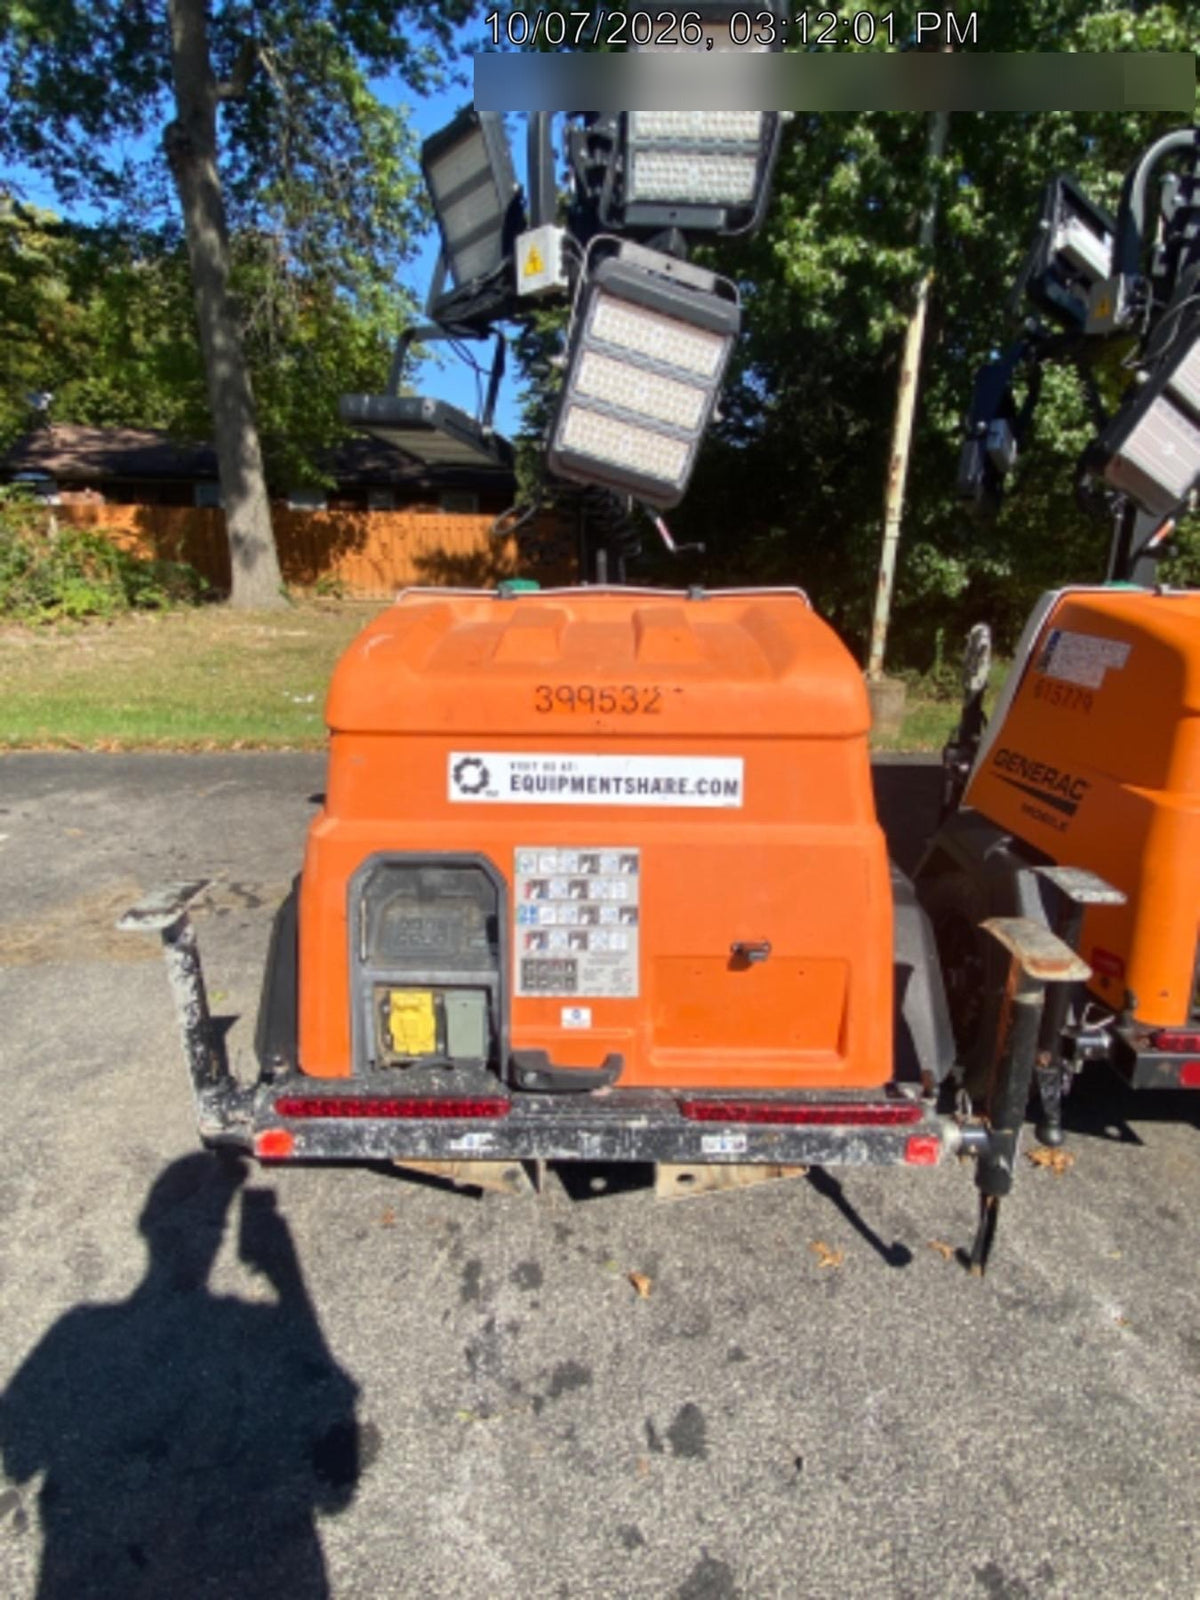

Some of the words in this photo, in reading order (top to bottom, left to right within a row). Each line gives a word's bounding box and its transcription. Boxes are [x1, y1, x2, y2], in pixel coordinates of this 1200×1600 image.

[535, 684, 661, 715] 399532
[510, 774, 739, 796] EQUIPMENTSHARE.COM
[993, 748, 1089, 801] GENERAC
